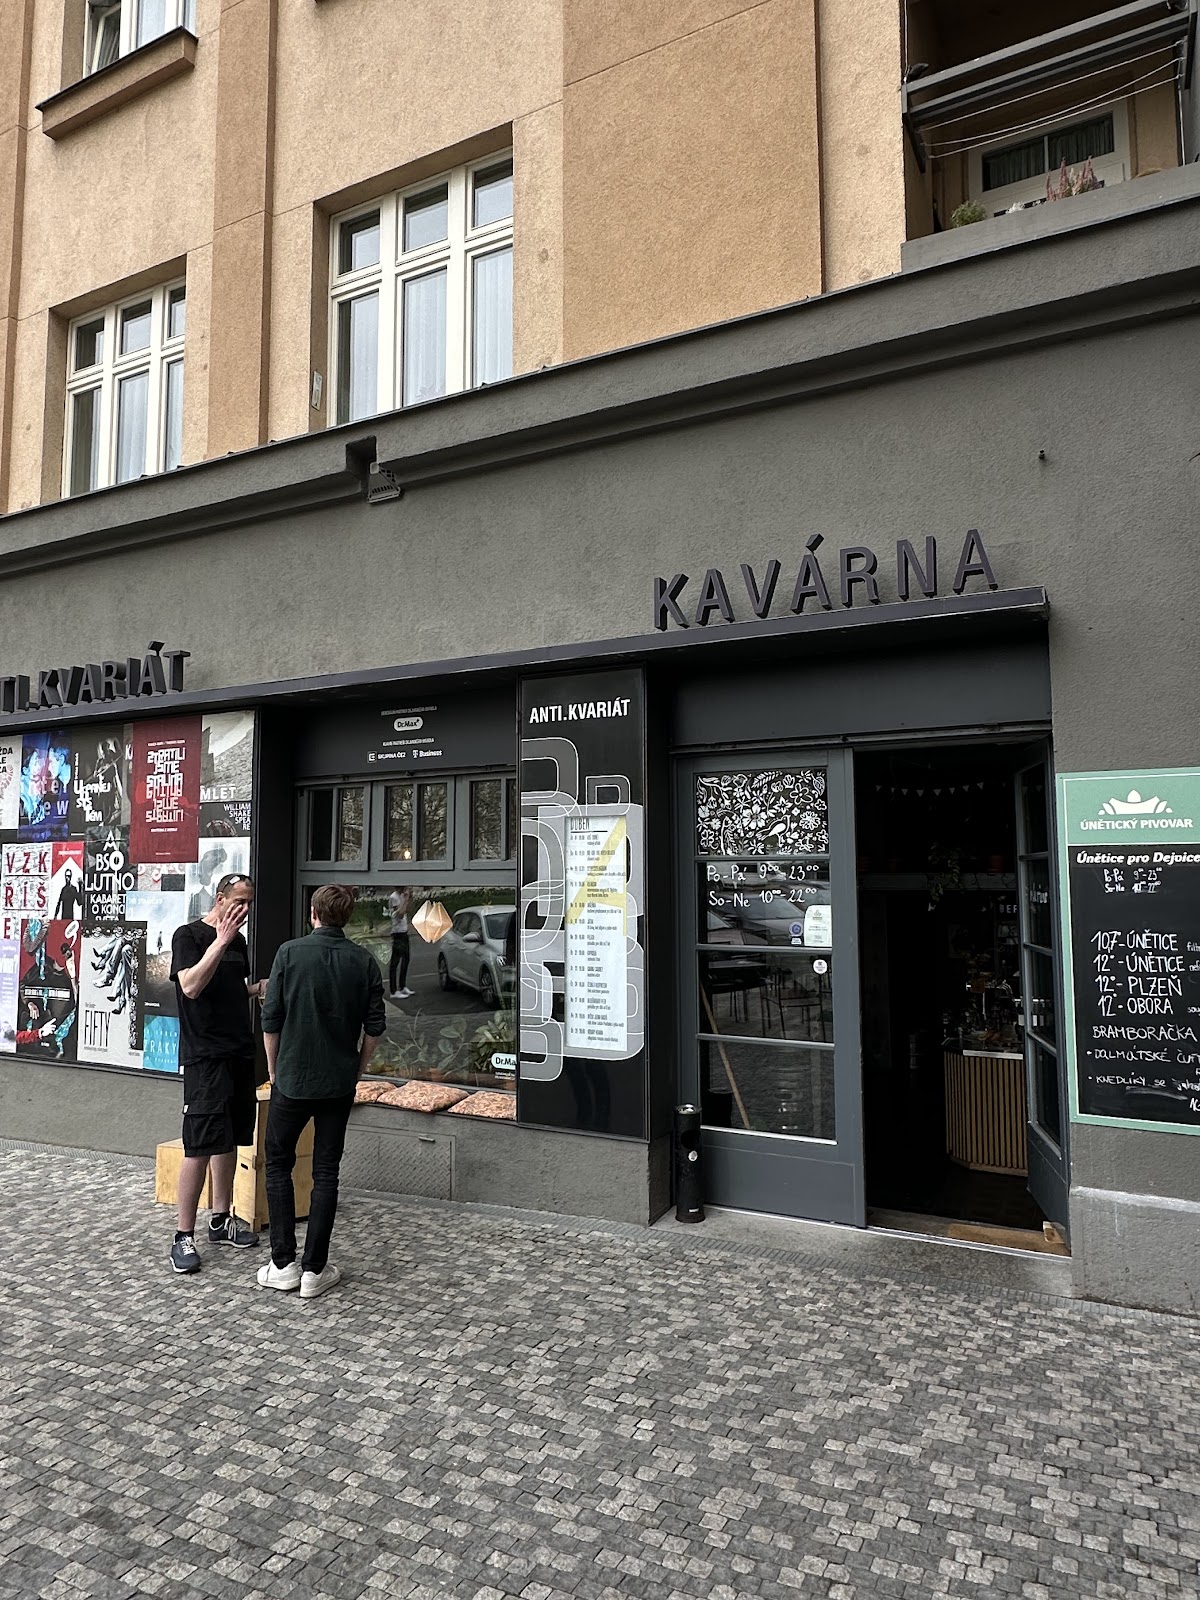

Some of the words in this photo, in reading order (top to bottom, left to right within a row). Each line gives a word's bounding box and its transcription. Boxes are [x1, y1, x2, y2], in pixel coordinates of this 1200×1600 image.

[653, 529, 998, 631] KAVÁRNA
[0, 641, 191, 713] TI.KVARIÁT
[529, 697, 631, 723] ANTI.KVARIÁT
[419, 750, 443, 758] Business
[200, 786, 236, 800] MLET
[223, 803, 251, 811] WILLIAM
[229, 810, 251, 818] SHAKE
[1080, 818, 1138, 830] ÚNĚTICKÝ
[1141, 818, 1194, 829] PIVOVAR
[96, 850, 124, 871] BSO
[1077, 850, 1124, 864] Únětice
[1127, 854, 1150, 866] pro
[84, 872, 135, 891] LUTNO
[90, 894, 126, 904] KABARET
[1126, 929, 1179, 951] ÚNĚTICE
[1125, 952, 1186, 973] ÚNĚTICE
[1127, 974, 1183, 997] PLZEŇ
[1127, 997, 1174, 1015] OBORA
[84, 1010, 111, 1047] FIFTY
[1092, 1023, 1198, 1043] BRAMBORAČKA
[495, 1056, 517, 1066] Dr.Ma
[1096, 1072, 1146, 1086] KNEDLÍKY
